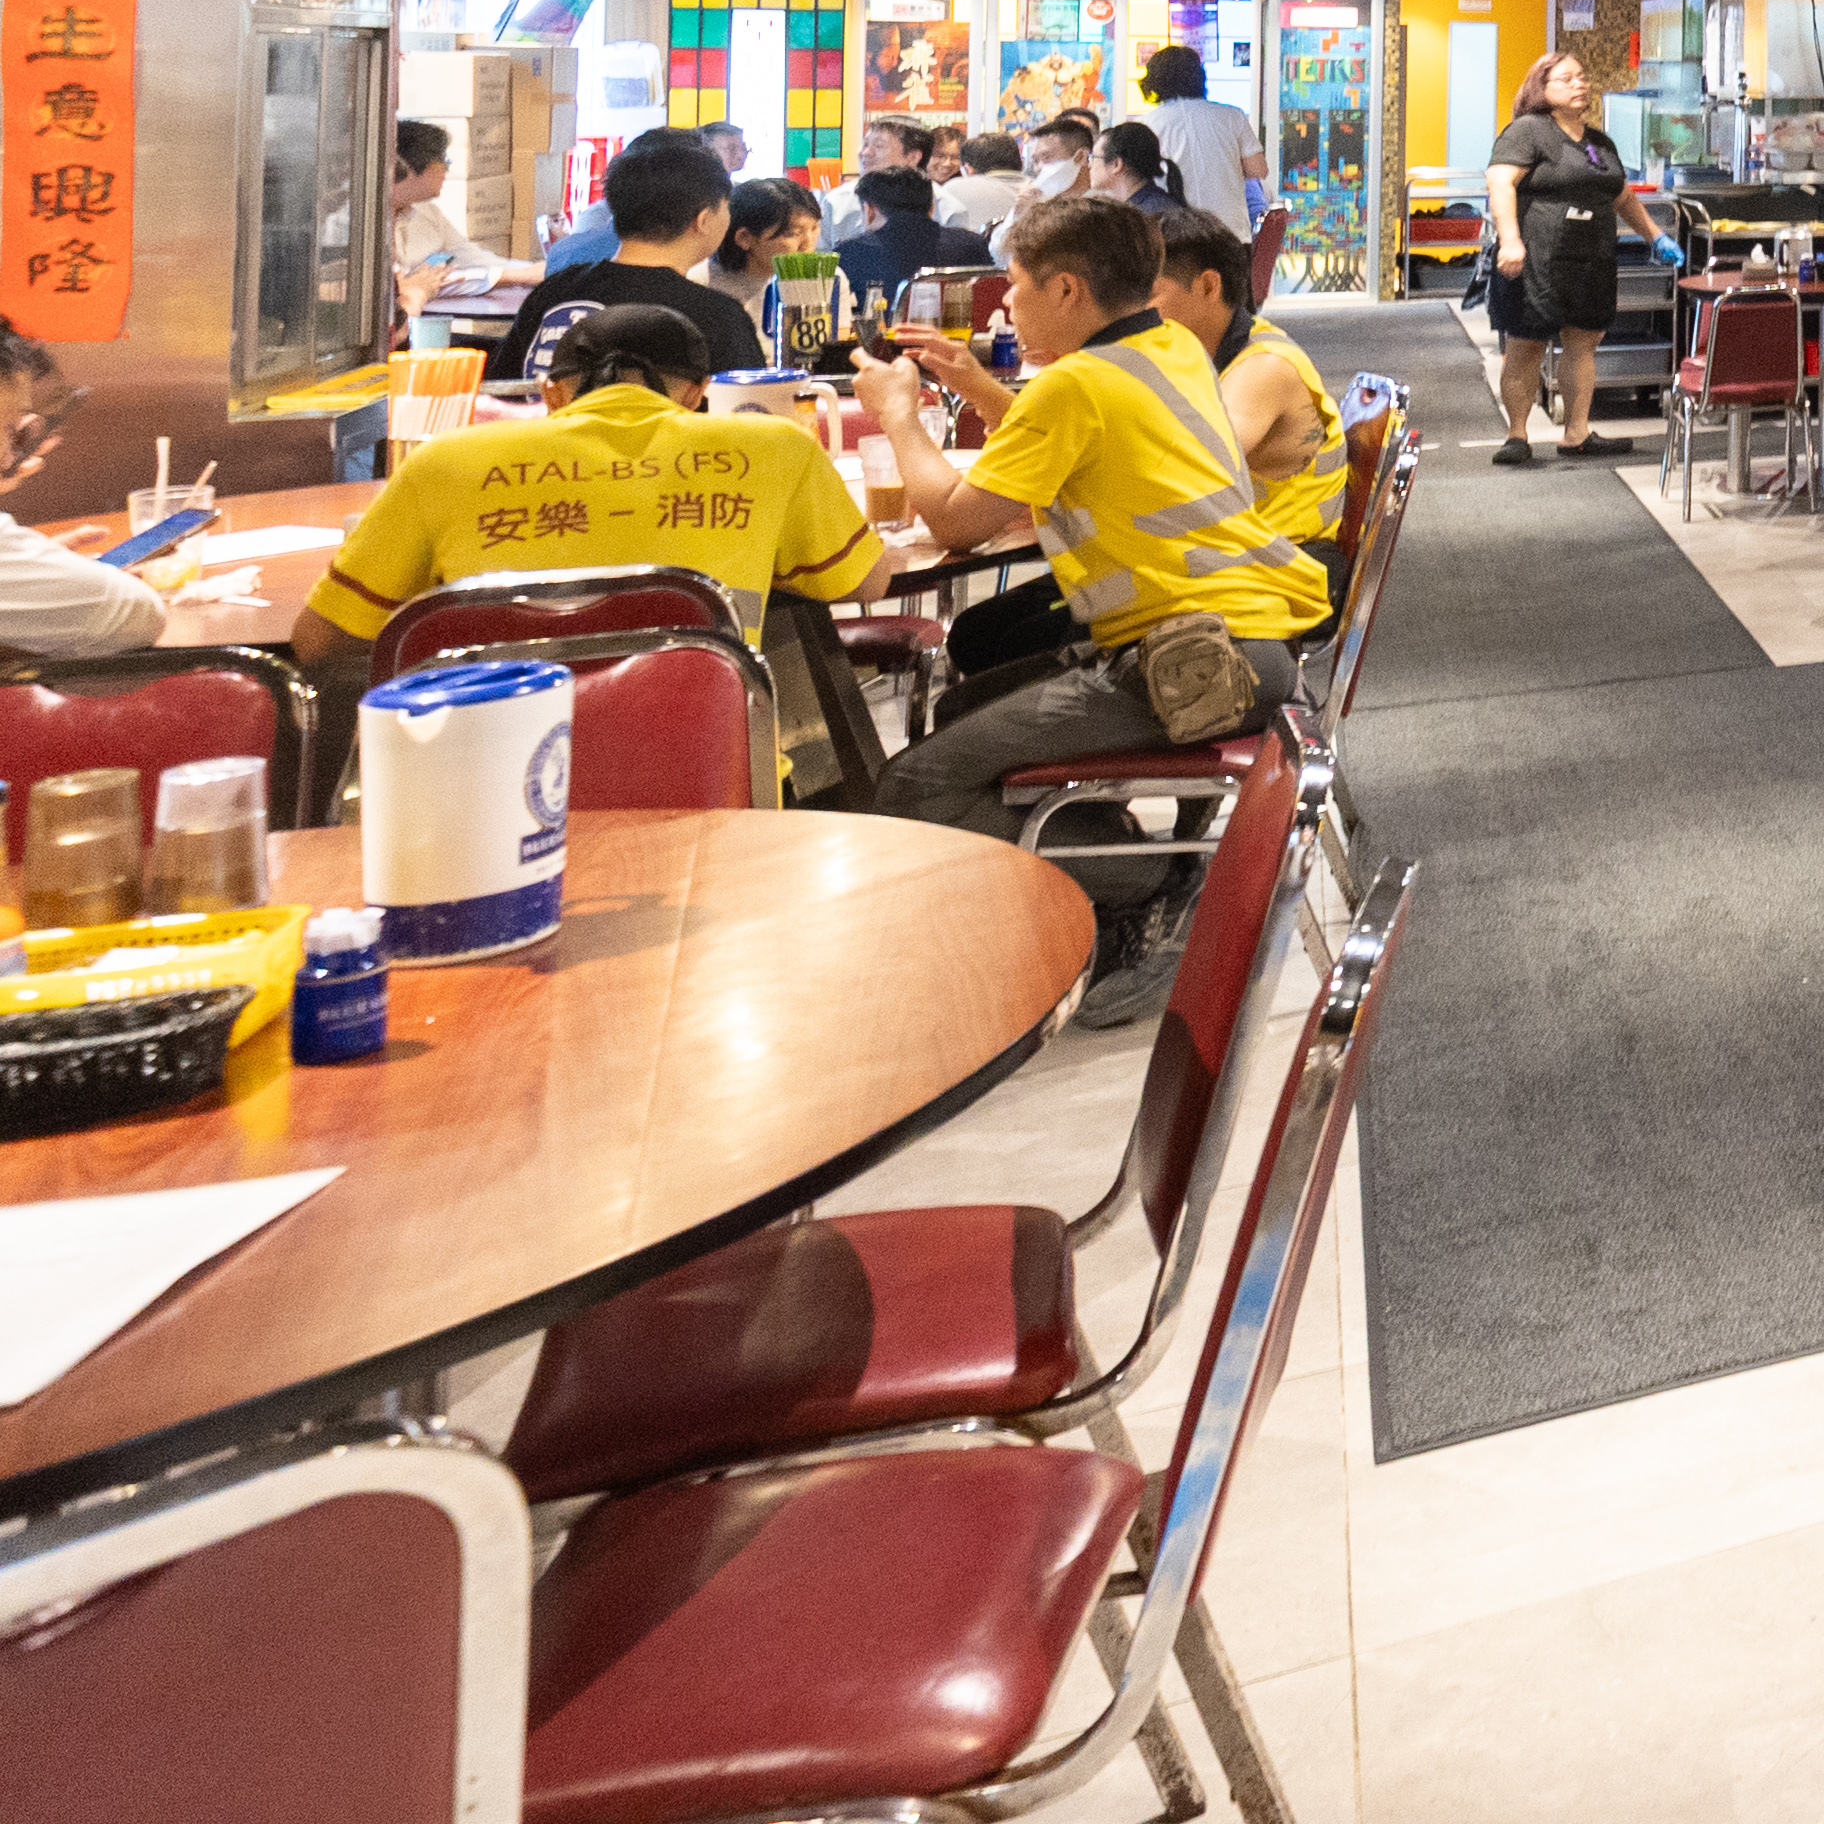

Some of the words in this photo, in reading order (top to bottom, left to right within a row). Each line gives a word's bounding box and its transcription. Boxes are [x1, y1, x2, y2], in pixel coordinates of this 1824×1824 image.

[796, 317, 828, 350] 88
[481, 458, 660, 491] ATAL-BS
[674, 449, 750, 481] (FS)
[477, 499, 590, 550] 安樂
[656, 490, 754, 531] 消防
